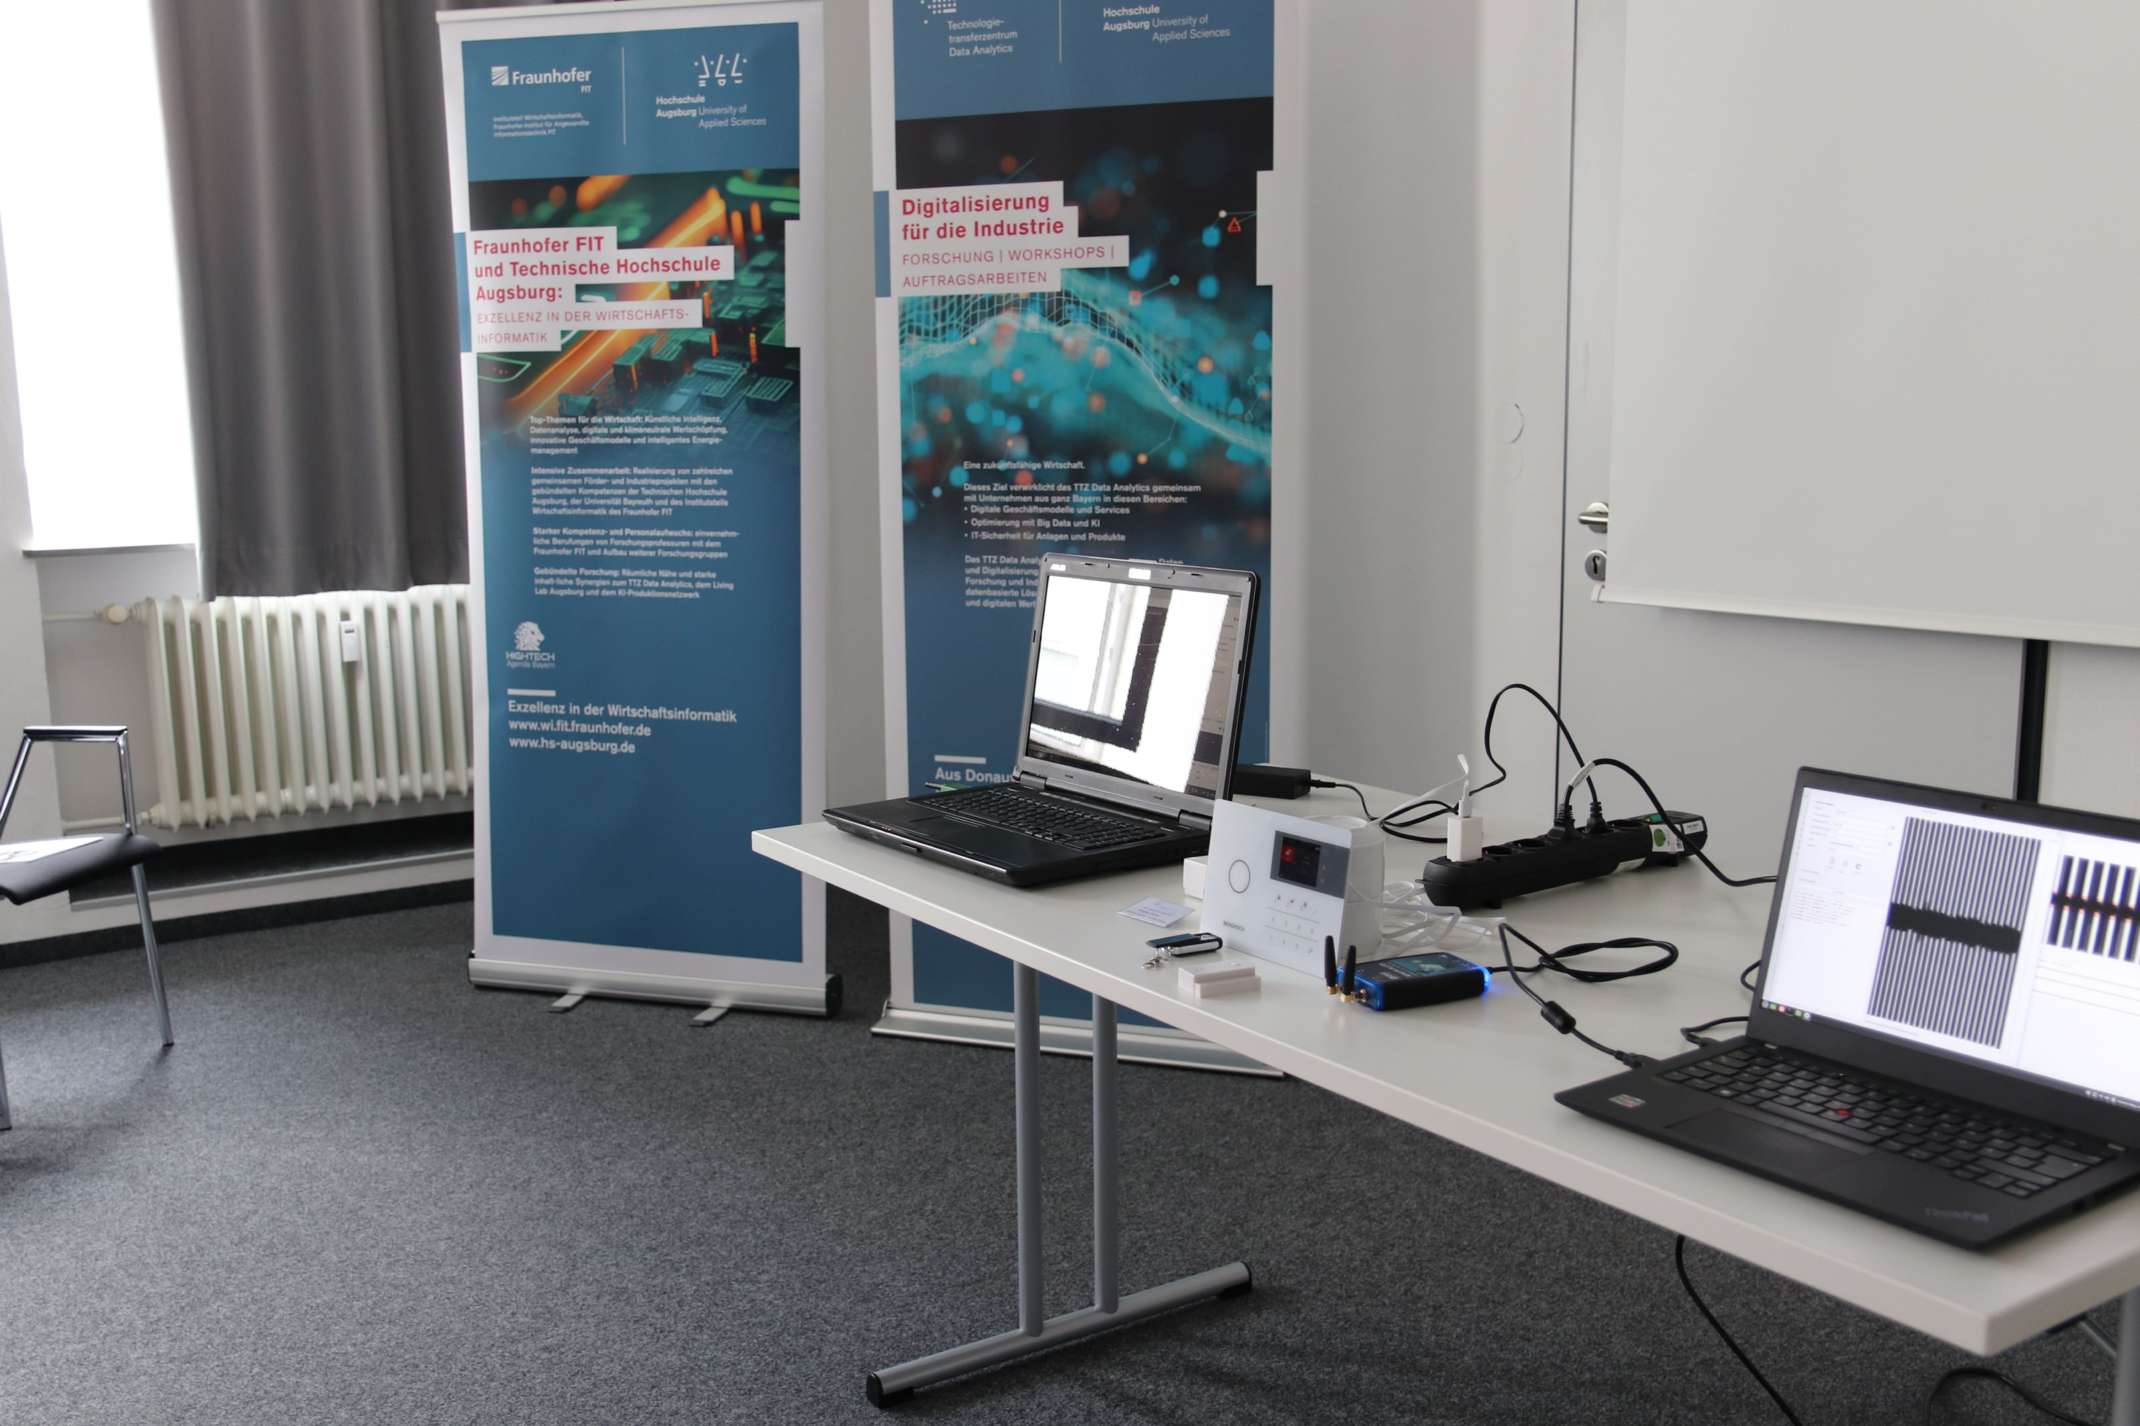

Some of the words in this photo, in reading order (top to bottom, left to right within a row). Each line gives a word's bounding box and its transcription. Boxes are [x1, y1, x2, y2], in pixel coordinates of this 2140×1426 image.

[1103, 5, 1160, 18] Hochschule
[948, 19, 1005, 31] Technologie-
[1103, 19, 1150, 32] Augsburg
[1152, 15, 1197, 28] University
[1199, 14, 1208, 25] of
[949, 32, 1018, 44] transferzentrum
[1152, 30, 1188, 44] Applied
[1190, 27, 1231, 40] Sciences
[949, 47, 971, 57] Data
[973, 45, 1014, 57] Analytics
[512, 67, 592, 85] Fraunhofer
[580, 85, 592, 93] FIT
[656, 94, 705, 105] Hochschule
[656, 107, 697, 119] Augsburg
[698, 105, 736, 117] University
[739, 104, 747, 113] of
[699, 118, 728, 131] Applied
[731, 117, 767, 127] Sciences
[902, 195, 1049, 218] Digitalisierung
[902, 223, 929, 240] für
[936, 222, 966, 239] die
[974, 218, 1064, 237] Industrie
[474, 237, 568, 255] Fraunhofer
[576, 236, 604, 252] FIT
[902, 251, 994, 265] FORSCHUNG
[1008, 245, 1105, 261] WORKSHOPS
[475, 262, 503, 278] und
[510, 259, 610, 276] Technische
[616, 256, 721, 274] Hochschule
[903, 271, 1048, 288] AUFTRAGSARBEITEN
[476, 285, 563, 304] Augsburg:
[477, 312, 542, 324] EXZELLENZ
[547, 311, 560, 322] IN
[565, 310, 591, 322] DER
[596, 308, 689, 321] WIRTSCHAFTS-
[477, 333, 548, 345] INFORMATIK
[582, 426, 608, 435] digitale
[609, 426, 623, 434] und
[530, 447, 578, 456] management
[963, 461, 981, 469] Eine
[1043, 461, 1086, 469] Wirtschaft.
[611, 477, 624, 485] und
[628, 488, 640, 496] der
[641, 488, 684, 496] Technischen
[685, 488, 727, 496] Hochschule
[963, 483, 991, 491] Dieses
[992, 483, 1008, 491] Ziel
[1009, 483, 1055, 492] verwirklicht
[1056, 483, 1072, 492] das
[1073, 483, 1091, 491] TTZ
[1091, 483, 1111, 491] Data
[1113, 483, 1151, 493] Analytics
[1152, 484, 1201, 493] gemeinsam
[670, 498, 683, 506] des
[963, 494, 977, 502] mit
[978, 494, 1033, 502] Unternehmen
[1051, 495, 1071, 504] ganz
[1072, 494, 1102, 504] Bayern
[1103, 495, 1111, 503] in
[1113, 495, 1141, 503] diesen
[623, 508, 660, 516] Fraunhofer
[661, 508, 672, 516] FIT
[970, 504, 1001, 514] Digitale
[1003, 504, 1075, 513] Geschäftsmodelle
[1076, 505, 1093, 513] und
[1094, 505, 1130, 514] Services
[971, 518, 1020, 528] Optimierung
[1021, 519, 1035, 527] mit
[1037, 518, 1051, 528] Big
[1052, 518, 1072, 527] Data
[1073, 519, 1089, 527] und
[1091, 519, 1101, 527] KI
[533, 527, 561, 535] Starker
[609, 528, 623, 536] und
[971, 531, 1021, 540] IT-Sicherheit
[1023, 532, 1035, 540] für
[1036, 532, 1069, 542] Anlagen
[1071, 532, 1087, 540] und
[1088, 532, 1126, 541] Produkte
[533, 537, 550, 545] liche
[552, 537, 593, 547] Berufungen
[692, 539, 703, 547] mit
[705, 539, 721, 547] dem
[534, 547, 572, 555] Fraunhofer
[574, 547, 586, 555] FIT
[965, 555, 980, 564] Das
[982, 555, 998, 564] TTZ
[999, 555, 1018, 564] Data
[534, 567, 577, 575] Gebündelte
[579, 567, 620, 577] Forschung:
[678, 569, 693, 578] und
[694, 570, 717, 578] starke
[965, 566, 980, 575] und
[628, 578, 641, 587] TTZ
[642, 579, 660, 587] Data
[713, 581, 734, 590] Living
[965, 576, 1007, 587] Forschung
[1008, 577, 1024, 586] und
[535, 587, 549, 595] Lab
[550, 587, 584, 597] Augsburg
[585, 588, 600, 596] und
[601, 588, 617, 597] dem
[966, 587, 1020, 597] datenbasierte
[966, 599, 982, 607] und
[983, 599, 1018, 609] digitalen
[506, 651, 556, 662] HIGHTECH
[508, 700, 566, 714] Exzellenz
[569, 702, 580, 714] in
[584, 702, 605, 716] der
[607, 704, 737, 722] Wirtschaftsinformatik
[508, 719, 652, 737] www.wi.fit.fraunhofer.de
[509, 736, 636, 754] www.hs-augsburg.de
[935, 767, 962, 782] Aus
